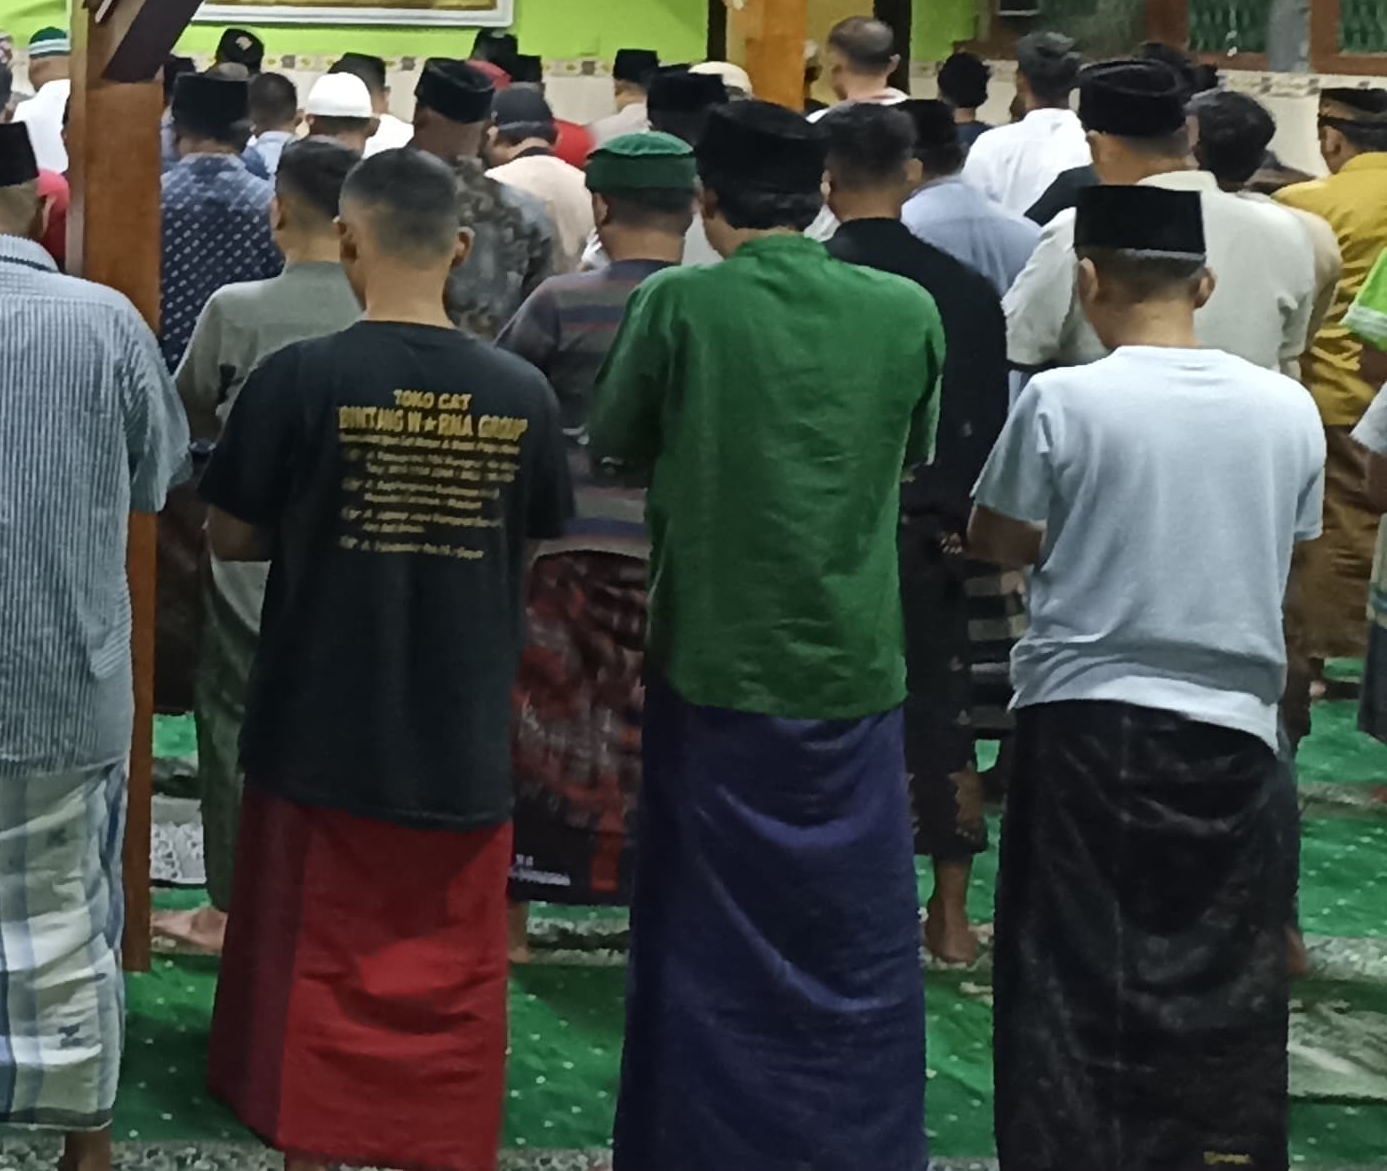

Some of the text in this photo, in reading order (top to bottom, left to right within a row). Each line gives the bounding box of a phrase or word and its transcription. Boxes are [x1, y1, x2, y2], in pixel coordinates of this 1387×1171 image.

[393, 389, 472, 411] TOKO CAT
[338, 405, 404, 432] BINTANG
[478, 414, 528, 441] GROUP
